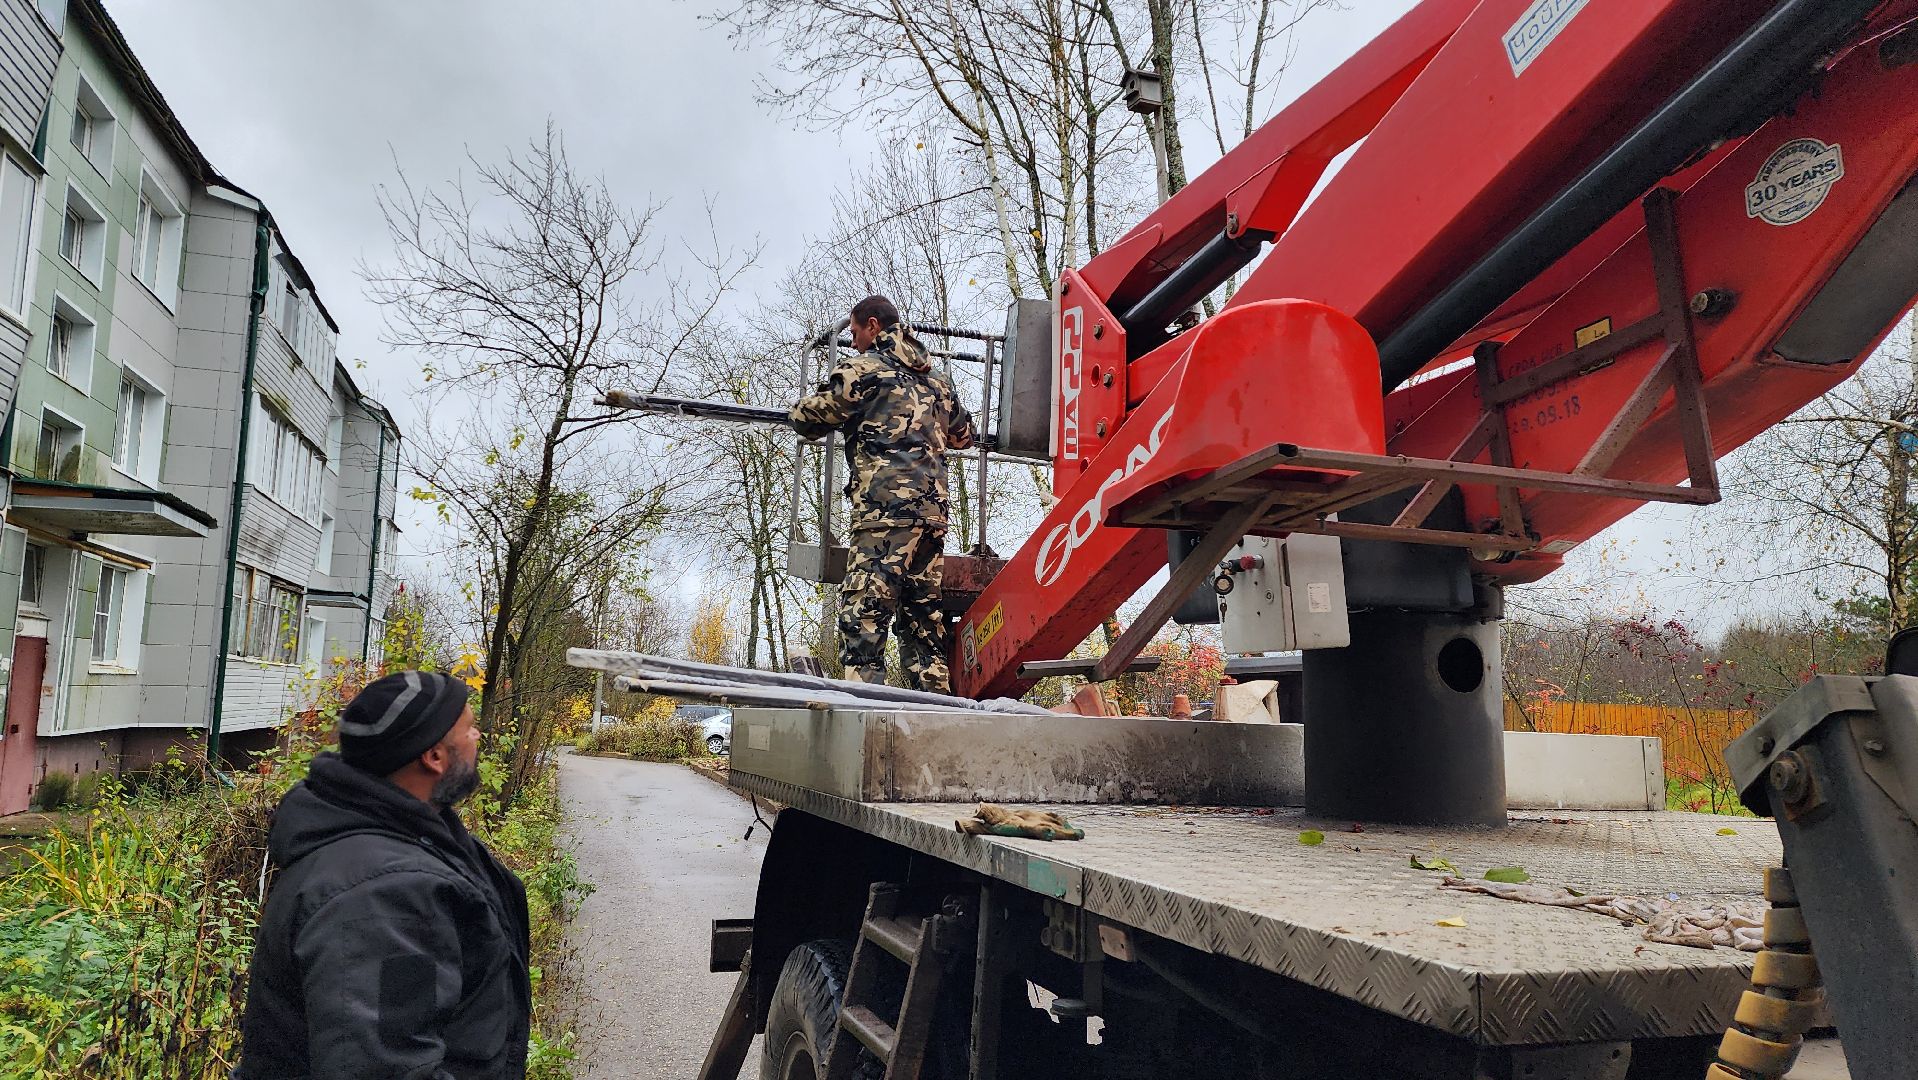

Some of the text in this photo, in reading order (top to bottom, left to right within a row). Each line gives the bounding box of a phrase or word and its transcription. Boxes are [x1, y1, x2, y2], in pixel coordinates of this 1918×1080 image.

[1752, 184, 1777, 208] 30
[1778, 159, 1837, 192] YEARS
[1062, 305, 1083, 460] DA22
